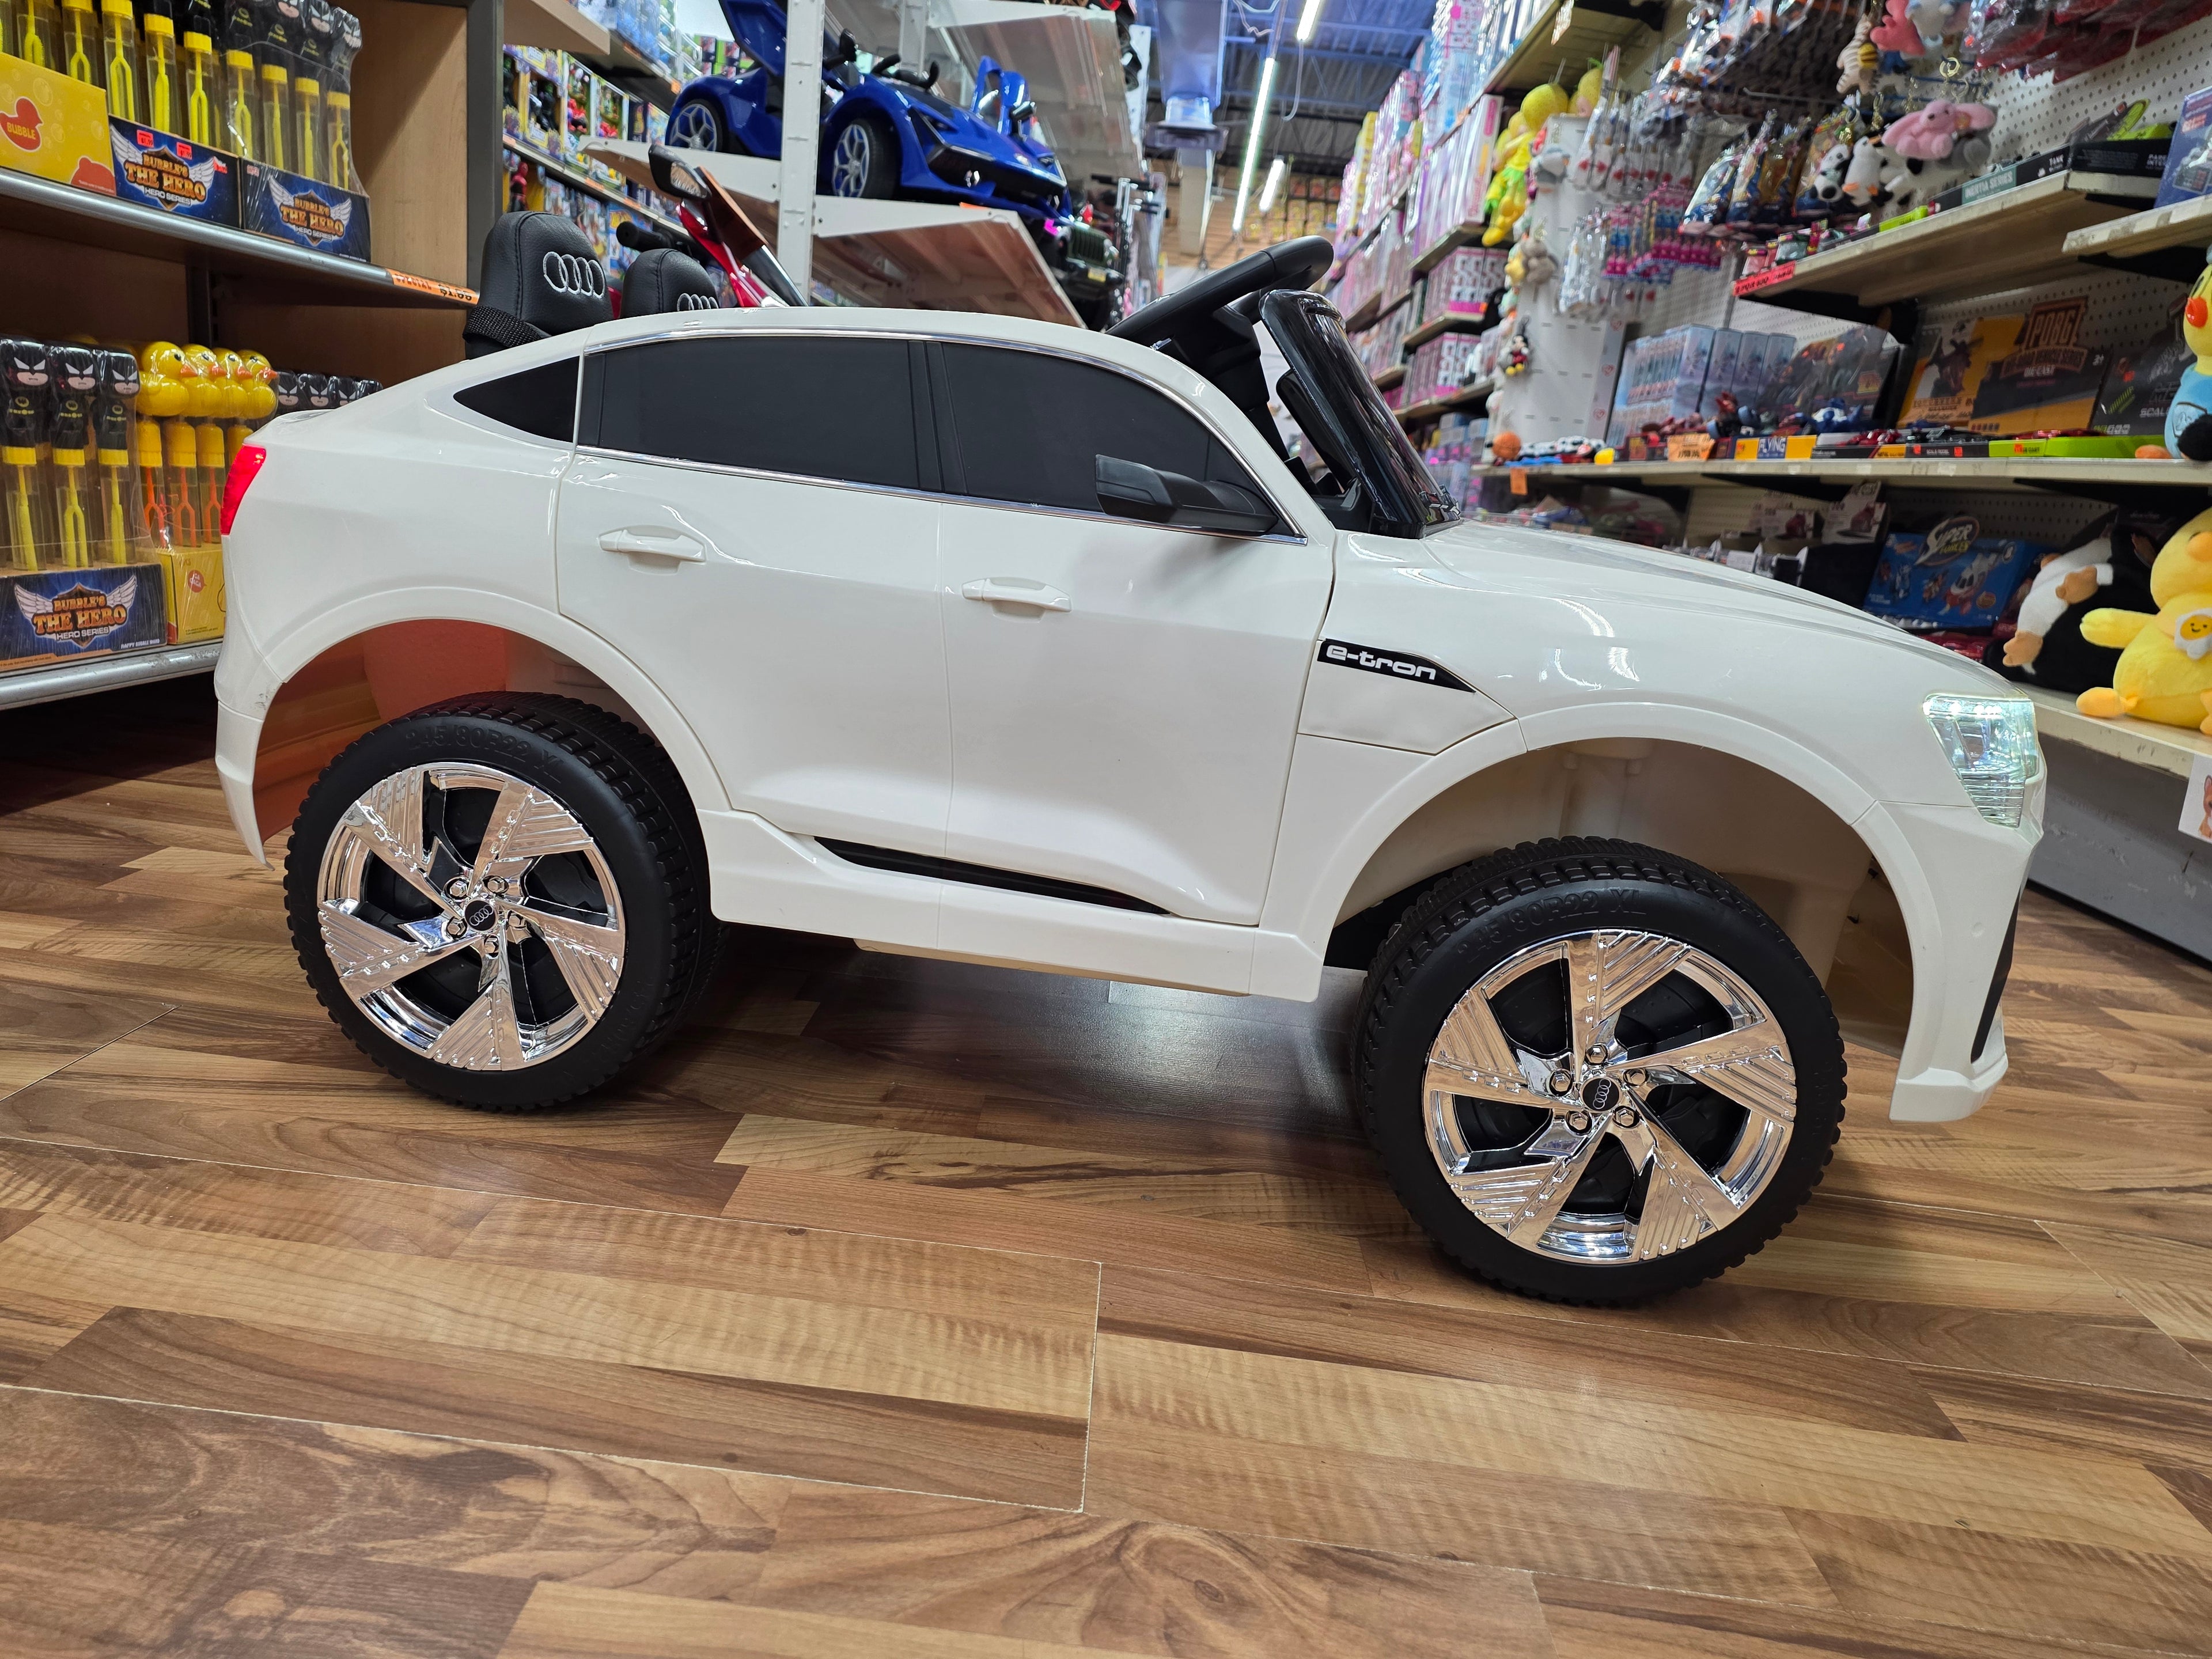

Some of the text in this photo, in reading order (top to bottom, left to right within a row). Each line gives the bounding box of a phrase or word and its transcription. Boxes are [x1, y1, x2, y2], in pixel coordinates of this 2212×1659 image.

[7, 122, 36, 140] BUBBLE
[143, 154, 188, 177] BUBBLE'S
[124, 162, 160, 189] THE
[162, 172, 206, 201] HERO
[1990, 171, 2013, 189] SERIES
[145, 188, 191, 206] HERO SERIES
[294, 198, 329, 216] BUBBLE'S
[281, 206, 344, 236] THE HERO
[296, 226, 332, 241] HERO SERIES
[1759, 438, 1786, 453] FLYING
[54, 596, 106, 612] BUBBLE'S
[33, 605, 127, 634] THE HERO
[56, 627, 109, 641] HERO SERIES
[1326, 644, 1437, 680] e-tron
